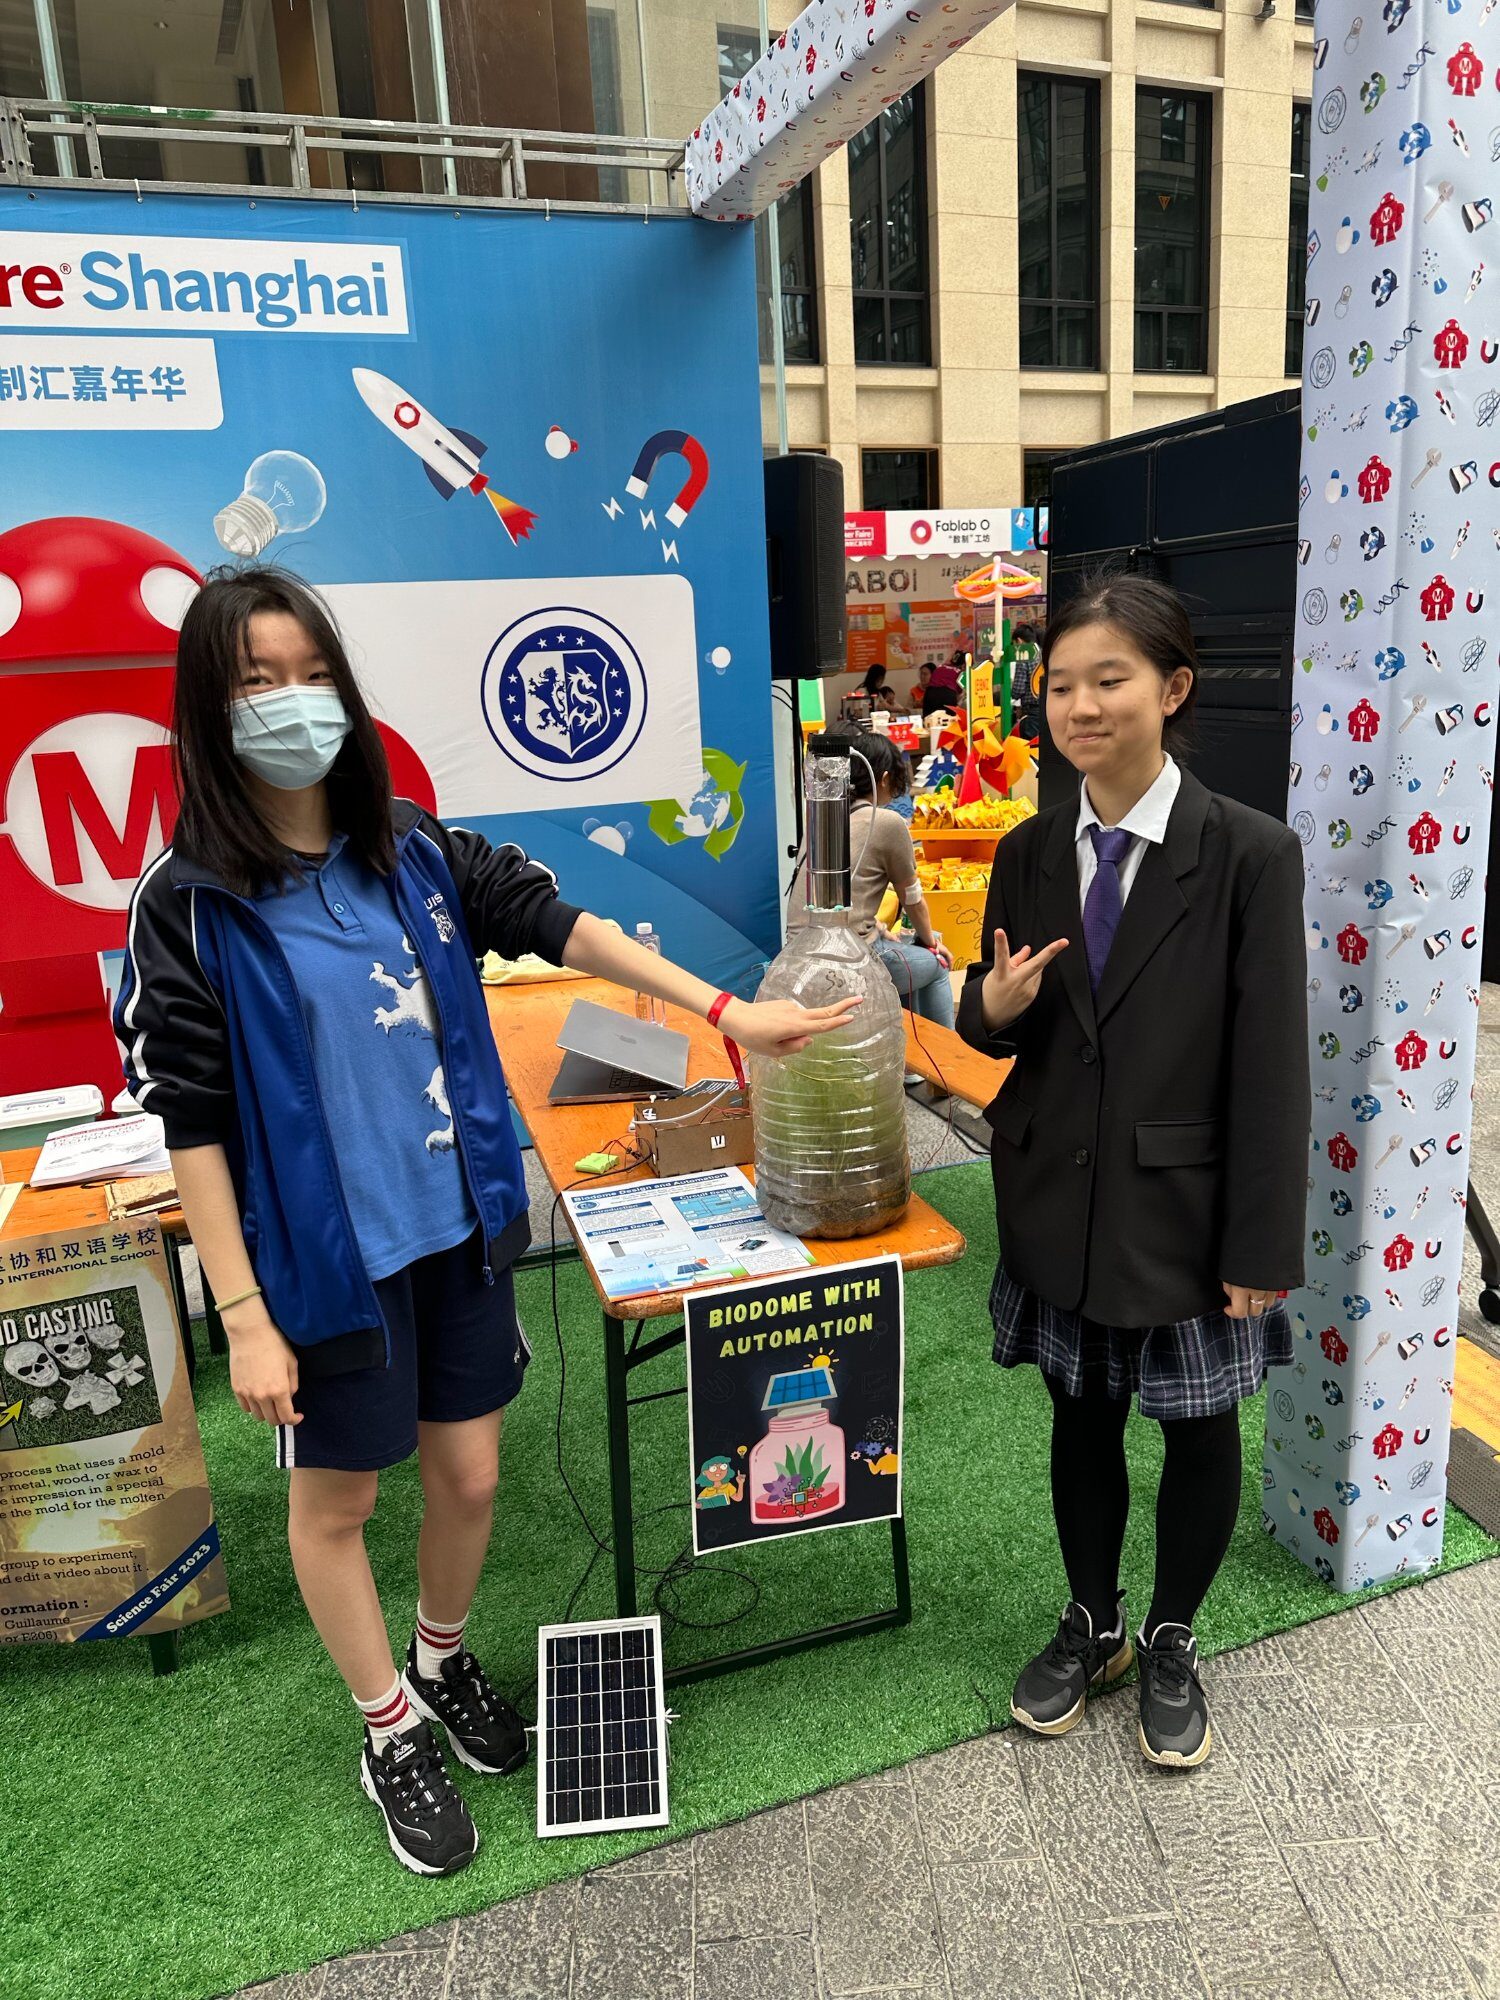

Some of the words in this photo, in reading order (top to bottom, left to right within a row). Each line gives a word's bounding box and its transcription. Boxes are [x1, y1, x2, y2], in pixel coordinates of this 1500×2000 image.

[80, 250, 389, 328] Shanghai
[0, 365, 187, 402] 制汇嘉年华
[936, 520, 977, 532] Fablab
[980, 519, 990, 531] O
[32, 744, 184, 885] M
[424, 893, 443, 910] UIS
[573, 1192, 617, 1202] Biodome
[618, 1185, 652, 1195] Design
[654, 1181, 672, 1189] and
[673, 1173, 727, 1186] Automation
[710, 1188, 737, 1197] Design
[630, 1221, 659, 1231] Design
[708, 1218, 754, 1229] Automation
[8, 1258, 107, 1283] INTERNATIONAL
[110, 1249, 160, 1264] SCHOOL
[708, 1290, 813, 1329] BIODOME
[824, 1278, 881, 1306] WITH
[0, 1319, 19, 1346] D
[25, 1298, 115, 1340] CASTING
[719, 1312, 873, 1358] AUTOMATION
[0, 1466, 52, 1481] process
[56, 1463, 81, 1473] that
[84, 1458, 115, 1469] uses
[118, 1456, 126, 1464] a
[129, 1445, 165, 1462] mold
[10, 1479, 51, 1492] metal,
[52, 1474, 94, 1487] wood,
[97, 1472, 111, 1480] or
[114, 1468, 141, 1478] wax
[144, 1464, 157, 1474] to
[12, 1489, 86, 1504] impression
[89, 1485, 103, 1495] in
[105, 1484, 114, 1492] a
[117, 1477, 165, 1492] special
[10, 1508, 32, 1518] the
[35, 1502, 70, 1515] mold
[73, 1500, 92, 1510] for
[96, 1497, 116, 1507] the
[120, 1493, 165, 1505] molten
[0, 1559, 39, 1573] group
[43, 1557, 55, 1566] to
[58, 1550, 137, 1565] experiment,
[14, 1572, 40, 1582] edit
[43, 1572, 52, 1580] a
[54, 1568, 91, 1579] video
[94, 1565, 130, 1575] about
[133, 1563, 143, 1573] it
[106, 1596, 153, 1633] Science
[150, 1572, 179, 1598] Fair
[178, 1543, 212, 1574] 2023
[0, 1600, 79, 1616] ormation
[4, 1616, 70, 1630] Guillaume
[5, 1635, 19, 1643] or
[21, 1630, 58, 1642] E206)
